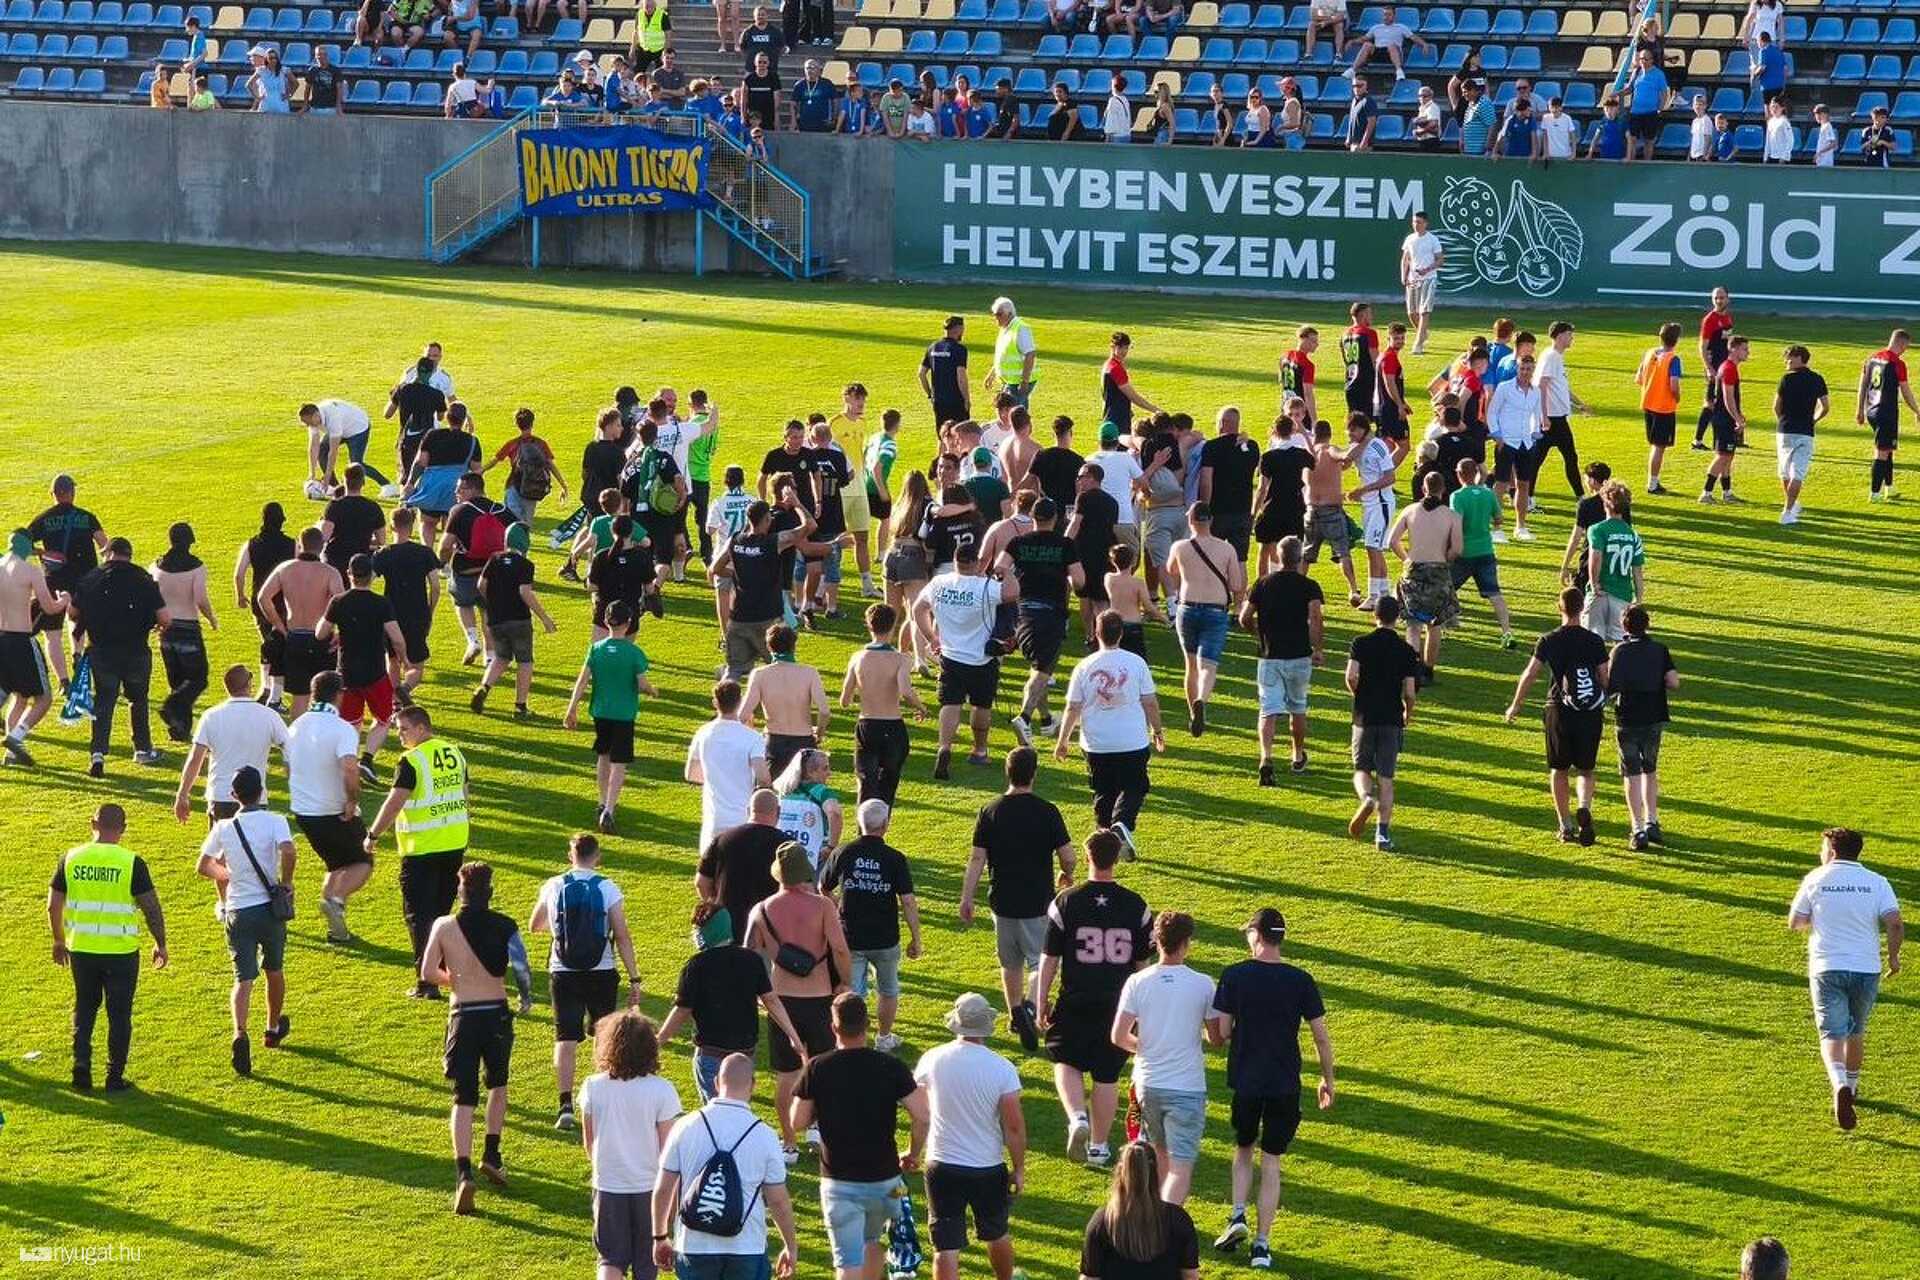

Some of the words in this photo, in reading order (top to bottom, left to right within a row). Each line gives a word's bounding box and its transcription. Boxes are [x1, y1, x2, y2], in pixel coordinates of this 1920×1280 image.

[521, 138, 619, 206] BAKONY
[942, 162, 1188, 213] HELYBEN
[1200, 171, 1425, 220] VESZEM
[576, 191, 664, 208] ULTRAS
[1609, 194, 1836, 272] Zöld
[942, 224, 1127, 272] HELYIT
[1137, 232, 1336, 281] ESZEM!
[1606, 543, 1634, 577] 70
[432, 747, 458, 772] 45
[73, 865, 122, 884] SECURITY
[1075, 926, 1133, 964] 36
